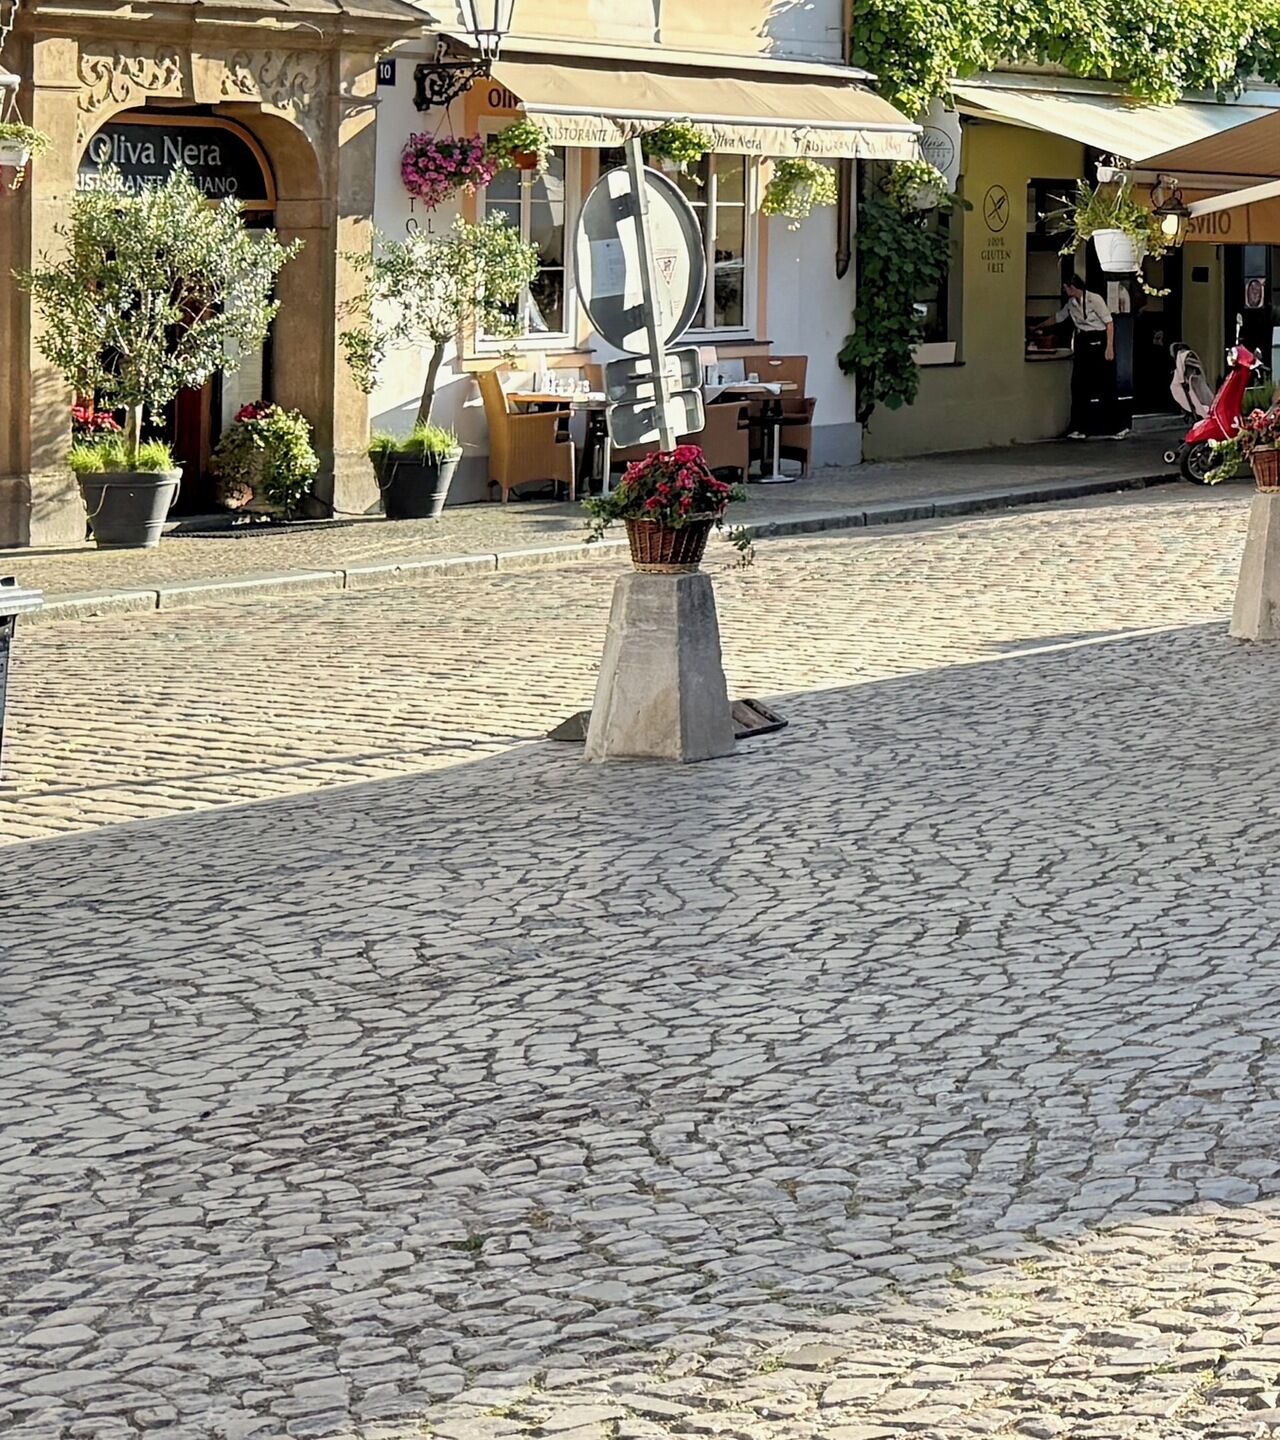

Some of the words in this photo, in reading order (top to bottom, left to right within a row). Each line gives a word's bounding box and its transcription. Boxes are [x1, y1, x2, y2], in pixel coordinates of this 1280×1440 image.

[379, 64, 392, 79] 10
[488, 88, 520, 108] Oli
[89, 133, 154, 165] Oliva
[163, 135, 222, 166] Nera
[75, 174, 163, 193] RISTRANTE
